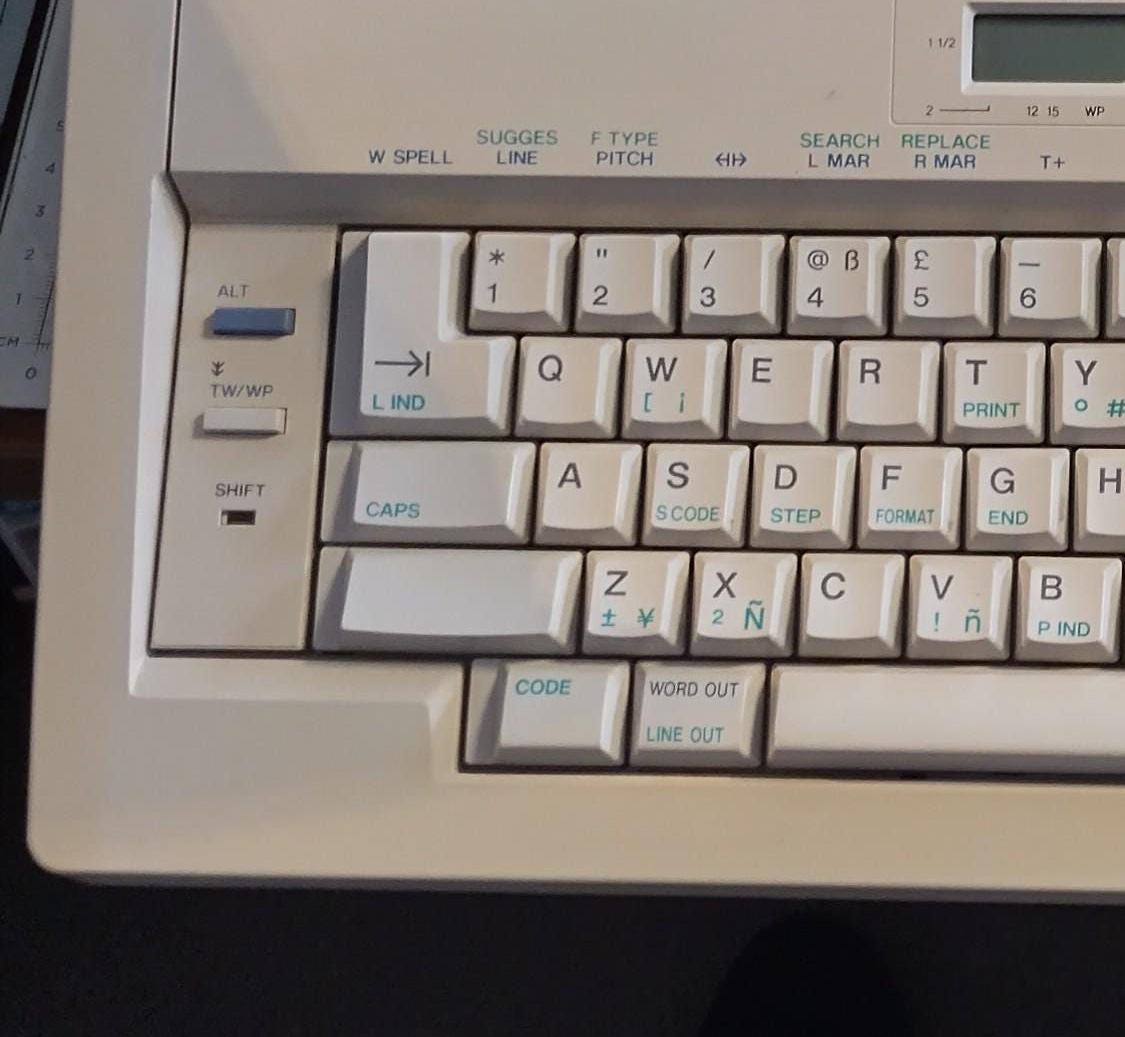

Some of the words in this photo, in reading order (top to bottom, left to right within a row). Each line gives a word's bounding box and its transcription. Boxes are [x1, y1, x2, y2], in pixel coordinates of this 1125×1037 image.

[926, 105, 933, 116] 2
[1027, 106, 1038, 116] 12
[1048, 106, 1059, 117] 15
[1086, 106, 1104, 116] WP
[477, 130, 558, 145] SUGGES
[592, 131, 600, 145] F
[606, 131, 658, 146] TYPE
[800, 133, 879, 148] SEARCH
[902, 134, 990, 149] REPLACE
[369, 150, 385, 164] W
[394, 150, 451, 164] SPELL
[497, 151, 537, 164] LINE
[597, 151, 653, 166] PITCH
[809, 154, 818, 167] L
[828, 154, 869, 167] MAR
[915, 154, 926, 168] R
[935, 154, 976, 168] MAR
[1040, 156, 1064, 169] T+
[35, 204, 46, 218] 3
[24, 248, 35, 261] 2
[808, 250, 829, 270] @
[915, 250, 929, 270] £
[15, 292, 22, 305] 1
[218, 285, 248, 298] ALT
[488, 284, 496, 303] 1
[593, 285, 608, 305] 2
[701, 287, 716, 307] 3
[808, 287, 823, 307] 4
[914, 287, 929, 307] 5
[1020, 288, 1036, 308] 6
[538, 355, 562, 381] Q
[646, 357, 677, 381] W
[752, 358, 772, 383] E
[860, 359, 881, 384] R
[966, 360, 987, 385] T
[1075, 360, 1097, 385] Y
[211, 384, 273, 397] TW/WP
[373, 394, 384, 410] L
[392, 395, 425, 411] IND
[964, 402, 1021, 417] PRINT
[558, 463, 581, 488] A
[667, 462, 689, 489] S
[775, 465, 797, 489] D
[882, 465, 901, 490] F
[991, 468, 1014, 494] G
[1100, 468, 1121, 493] H
[216, 483, 264, 497] SHIFT
[366, 502, 420, 518] CAPS
[656, 505, 667, 520] S
[672, 506, 720, 522] CODE
[771, 508, 821, 523] STEP
[876, 509, 935, 524] FORMAT
[989, 511, 1028, 525] END
[604, 571, 628, 596] Z
[713, 572, 737, 598] X
[821, 572, 845, 600] C
[931, 575, 953, 599] V
[1041, 575, 1062, 600] B
[638, 608, 654, 628] ¥
[744, 600, 764, 630] Ñ
[965, 609, 980, 633] ñ
[1038, 621, 1050, 635] P
[1058, 622, 1090, 636] IND
[516, 679, 572, 695] CODE
[650, 681, 698, 696] WORD
[705, 682, 739, 697] OUT
[647, 726, 682, 742] LINE
[690, 727, 724, 743] OUT
